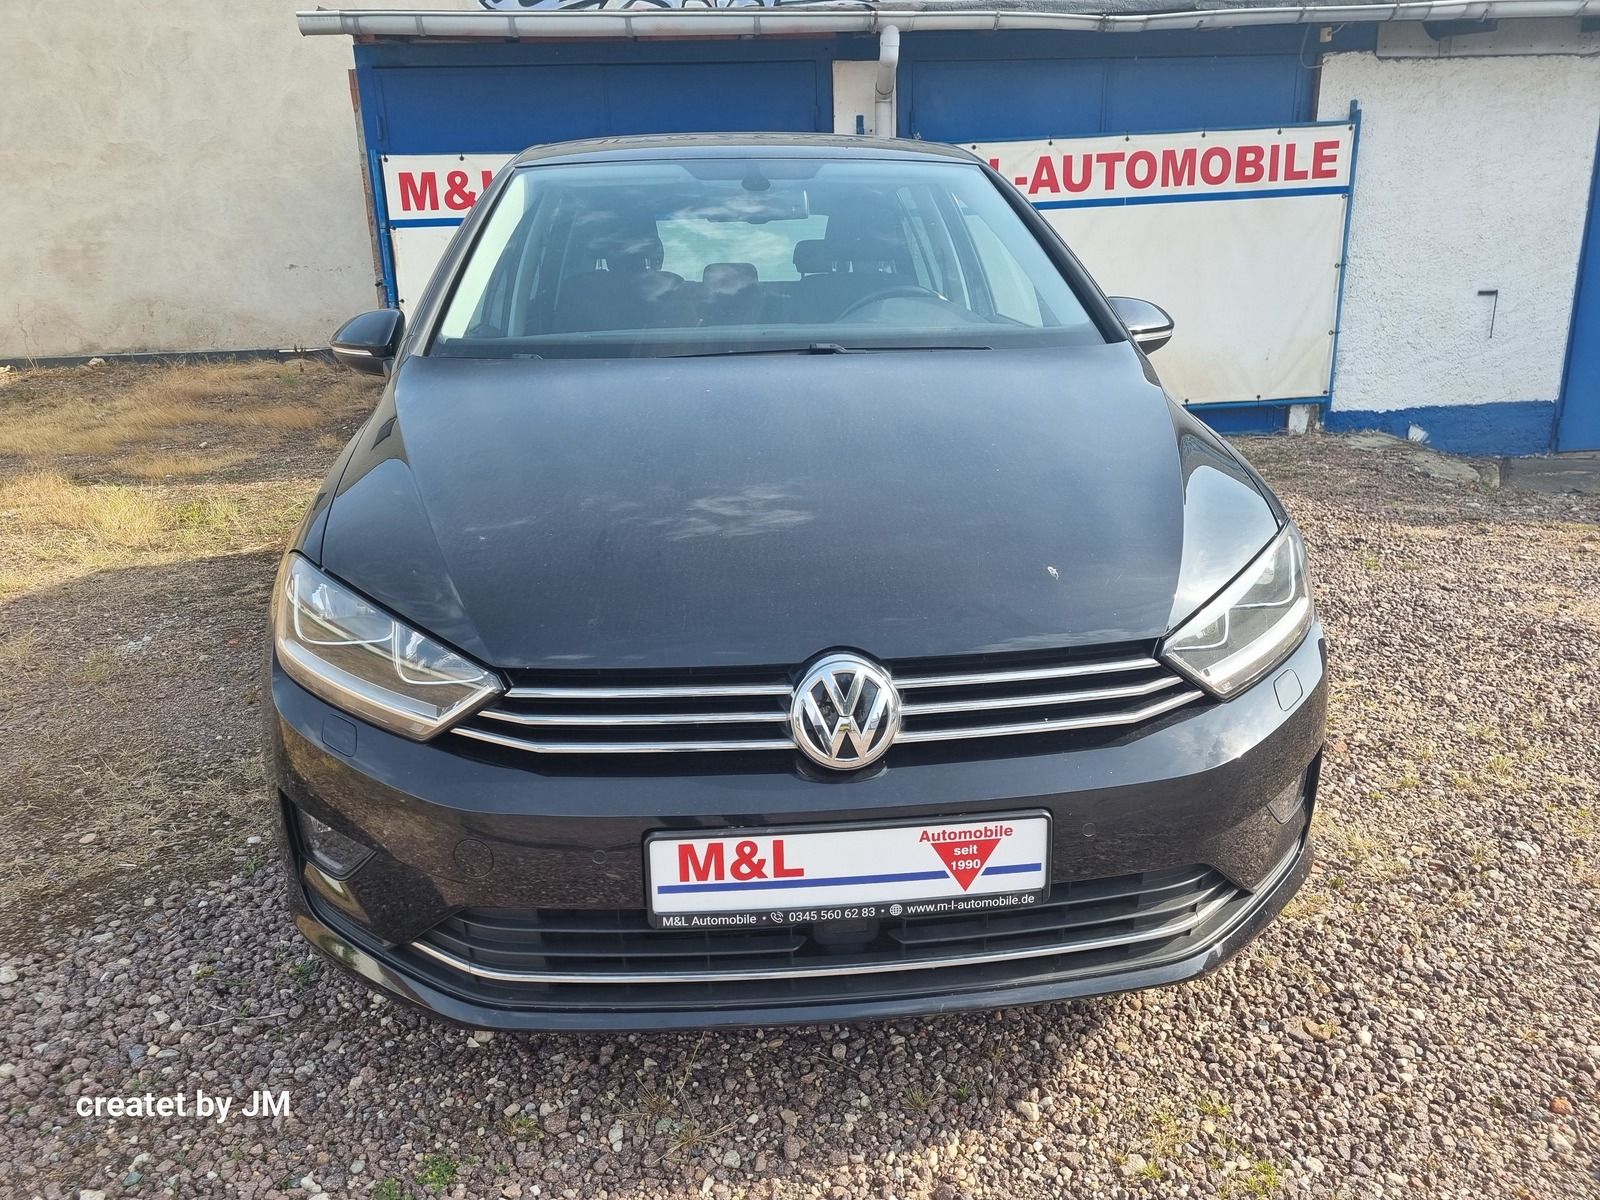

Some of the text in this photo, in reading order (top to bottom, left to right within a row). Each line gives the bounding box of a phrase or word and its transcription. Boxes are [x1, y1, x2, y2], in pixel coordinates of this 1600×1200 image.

[796, 661, 894, 764] VW
[919, 825, 1013, 843] Automobile
[678, 840, 804, 882] M&L
[953, 844, 978, 856] seit
[950, 858, 981, 871] 1990
[662, 894, 1035, 927] M&L Automobile 0345 560 62 83 www.m-l-automobile.de
